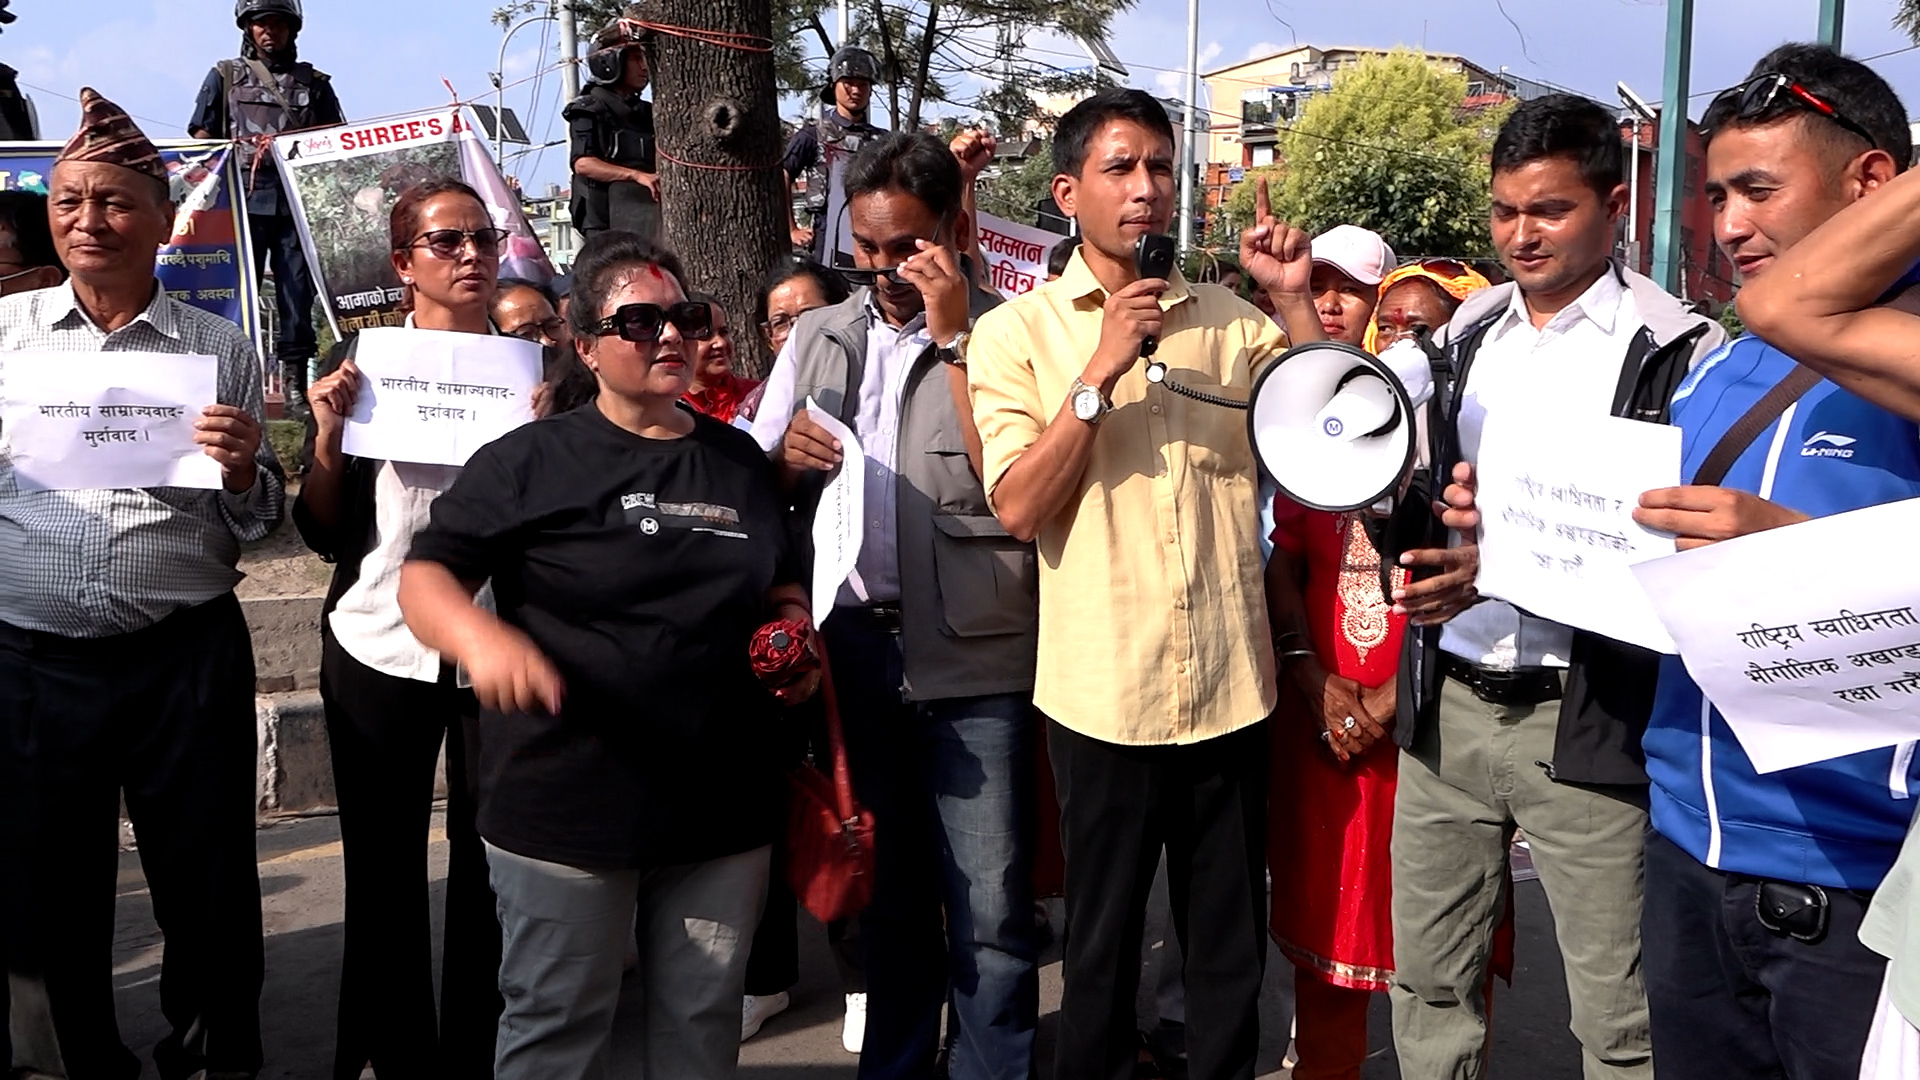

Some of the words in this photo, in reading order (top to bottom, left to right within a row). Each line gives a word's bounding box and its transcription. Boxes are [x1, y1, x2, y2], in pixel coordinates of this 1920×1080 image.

[340, 117, 443, 150] SHREE'S
[978, 227, 1046, 265] सम्मान
[335, 285, 387, 310] आमाको
[380, 375, 430, 393] भारतीय
[39, 401, 91, 418] भारतीय
[1808, 606, 1919, 638] स्वाधिनता
[1744, 658, 1839, 684] भौगोलिक
[1833, 685, 1883, 703] रक्षा
